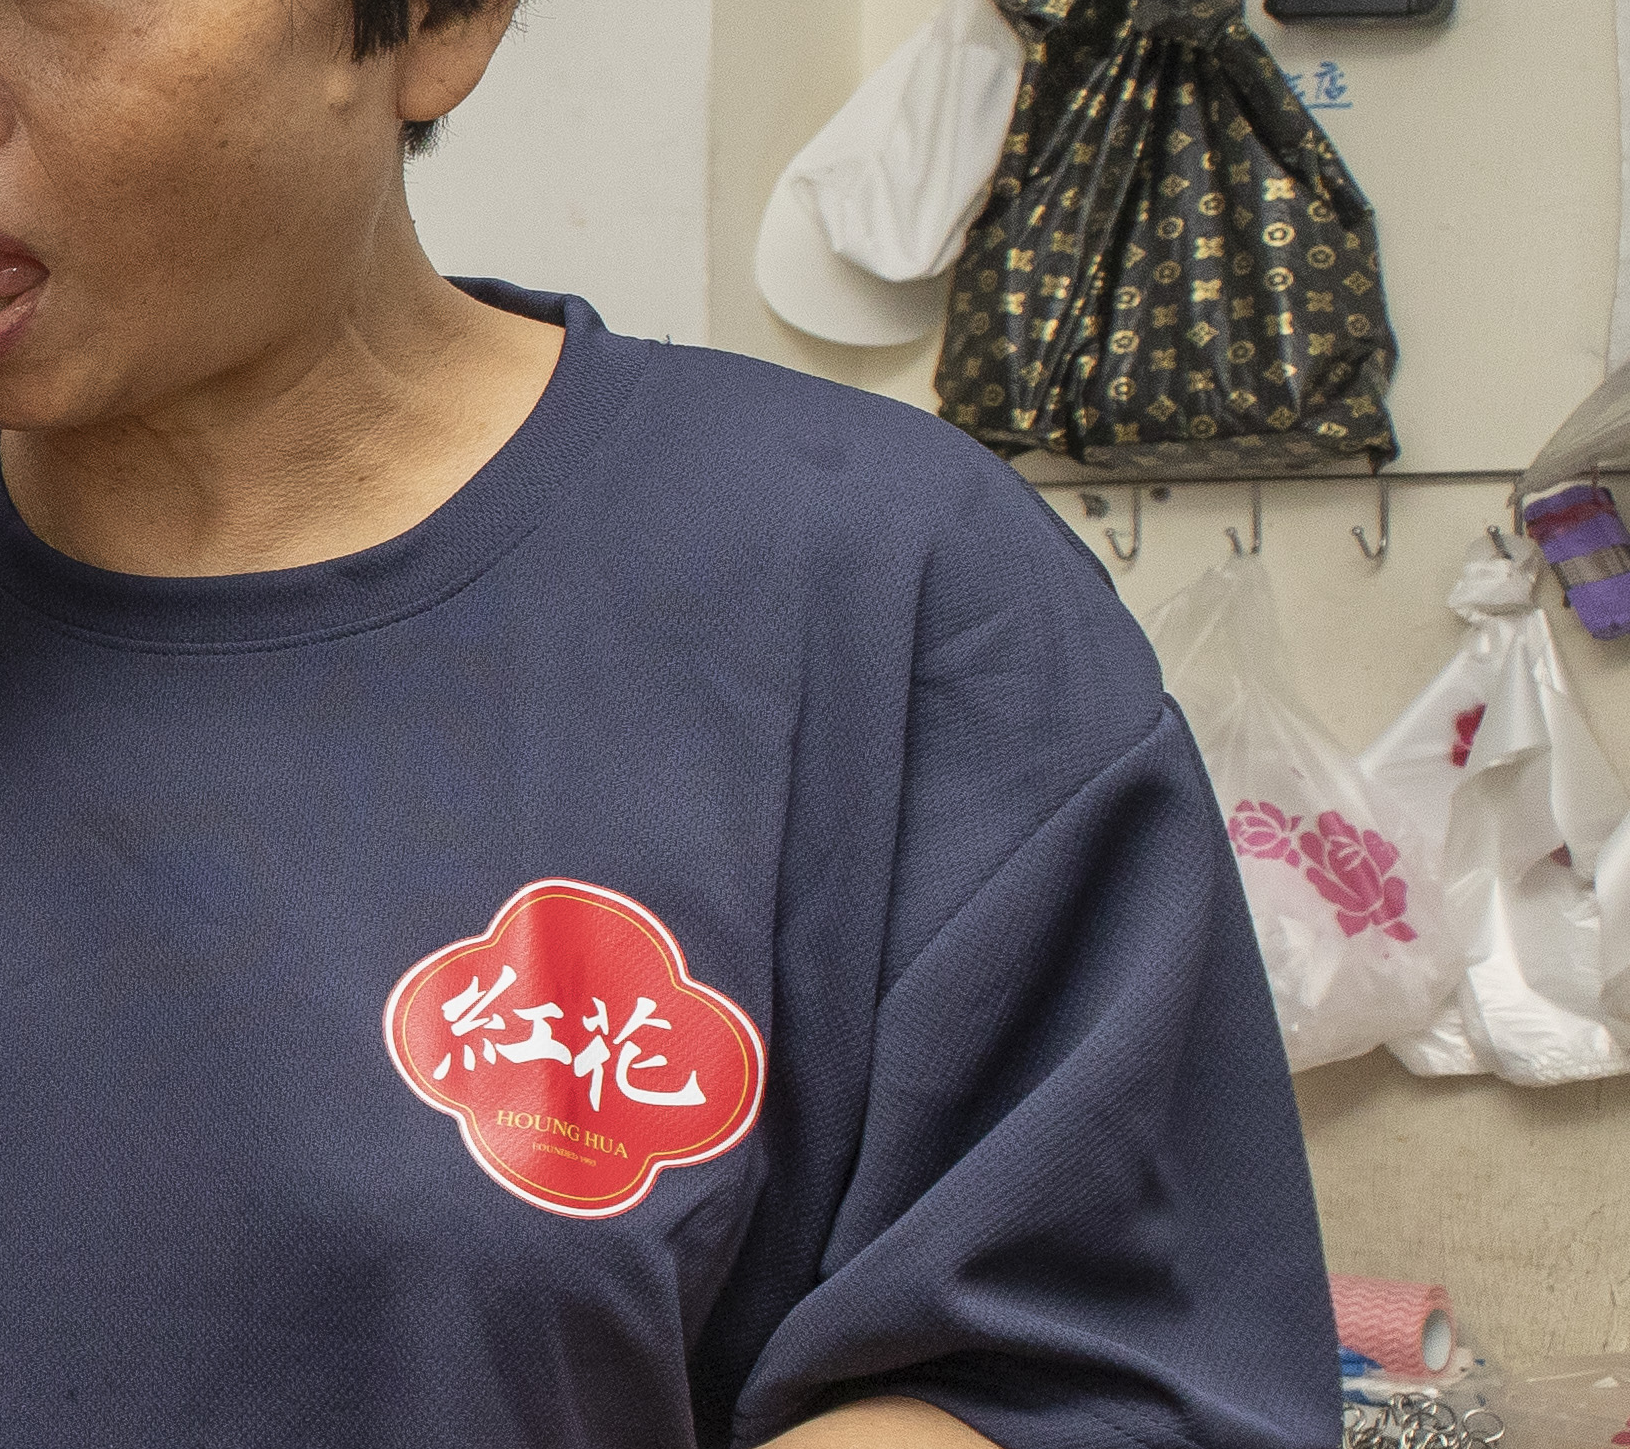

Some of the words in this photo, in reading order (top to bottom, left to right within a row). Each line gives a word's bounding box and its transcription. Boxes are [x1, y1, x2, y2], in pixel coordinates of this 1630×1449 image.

[433, 965, 707, 1112] 紅花
[496, 1109, 580, 1142] HOUNG
[584, 1130, 629, 1159] HUA
